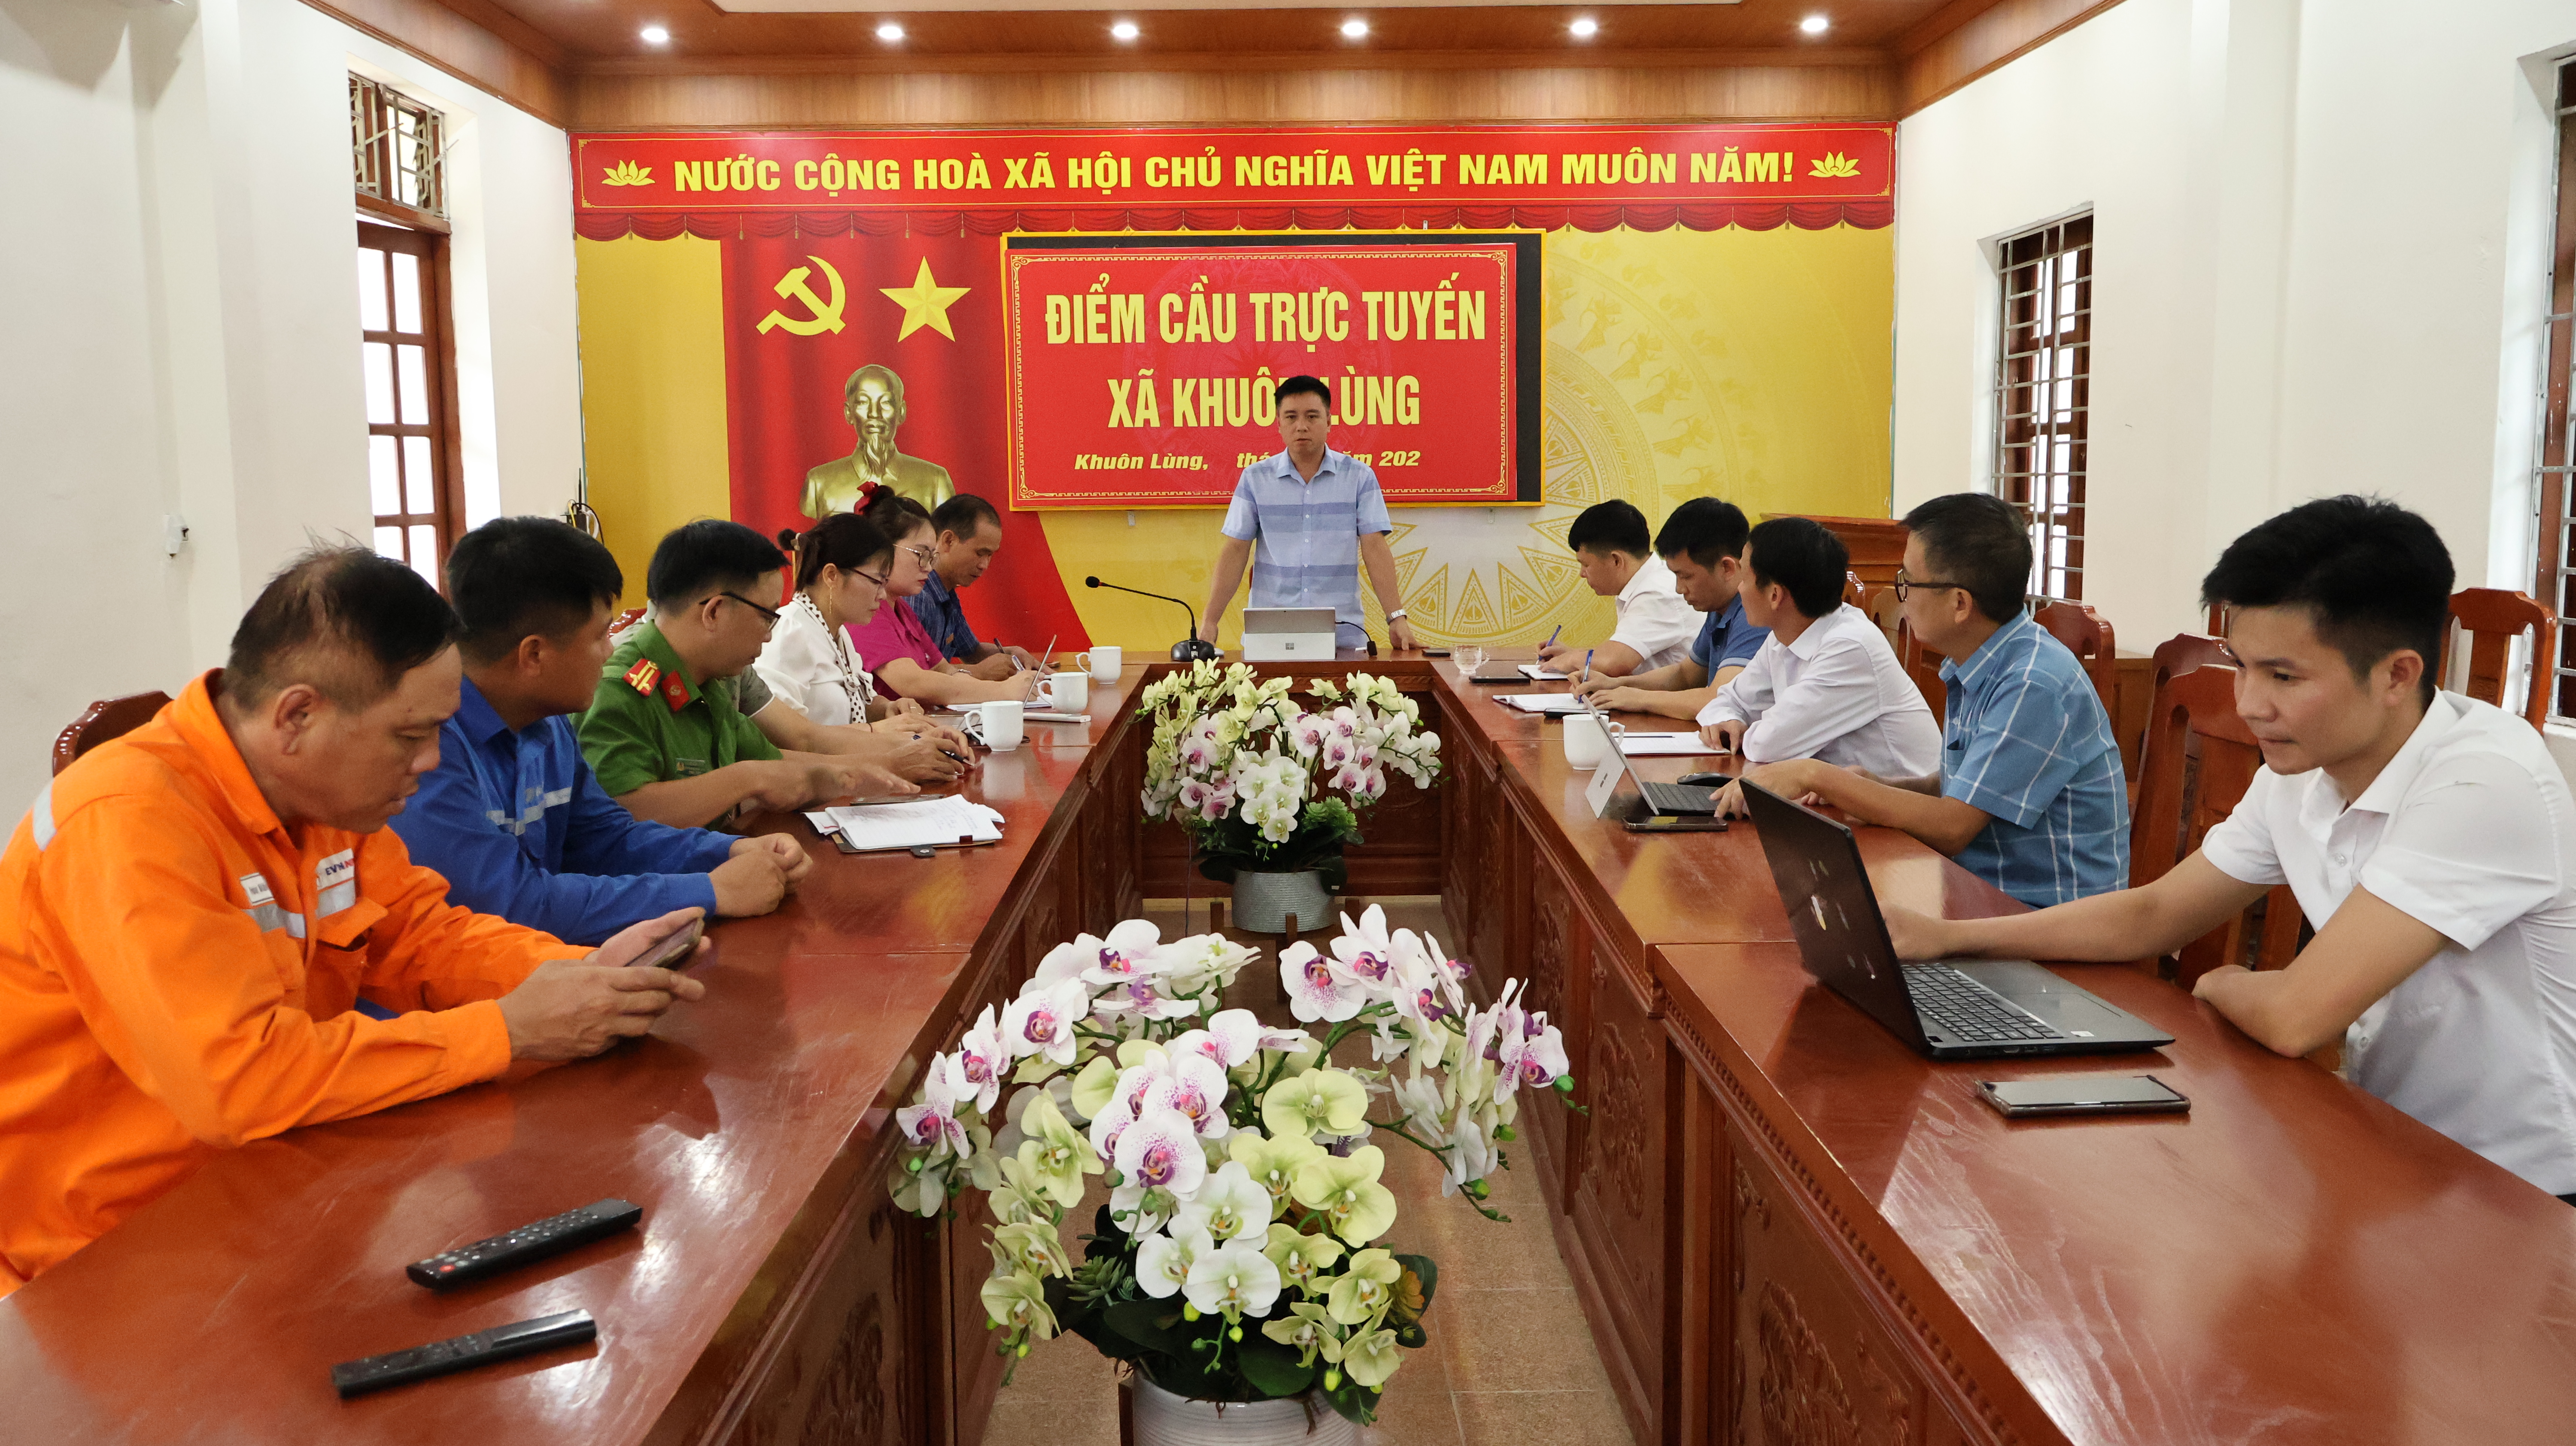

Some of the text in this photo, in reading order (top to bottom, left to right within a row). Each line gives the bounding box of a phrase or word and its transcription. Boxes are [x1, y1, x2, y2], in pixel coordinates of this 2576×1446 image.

[674, 146, 1793, 197] NƯỚC CỘNG HOÀ XÃ HỘI CHỦ NGHĨA VIỆT NAM MUÔN NĂM!
[1045, 272, 1485, 352] ĐIỂM CẦU TRỰC TUYẾN
[1107, 368, 1160, 428] XÃ
[1173, 366, 1289, 427] KHUÔ
[1074, 453, 1144, 470] Khuôn
[1150, 453, 1208, 470] Lùng,
[1379, 450, 1421, 466] 202
